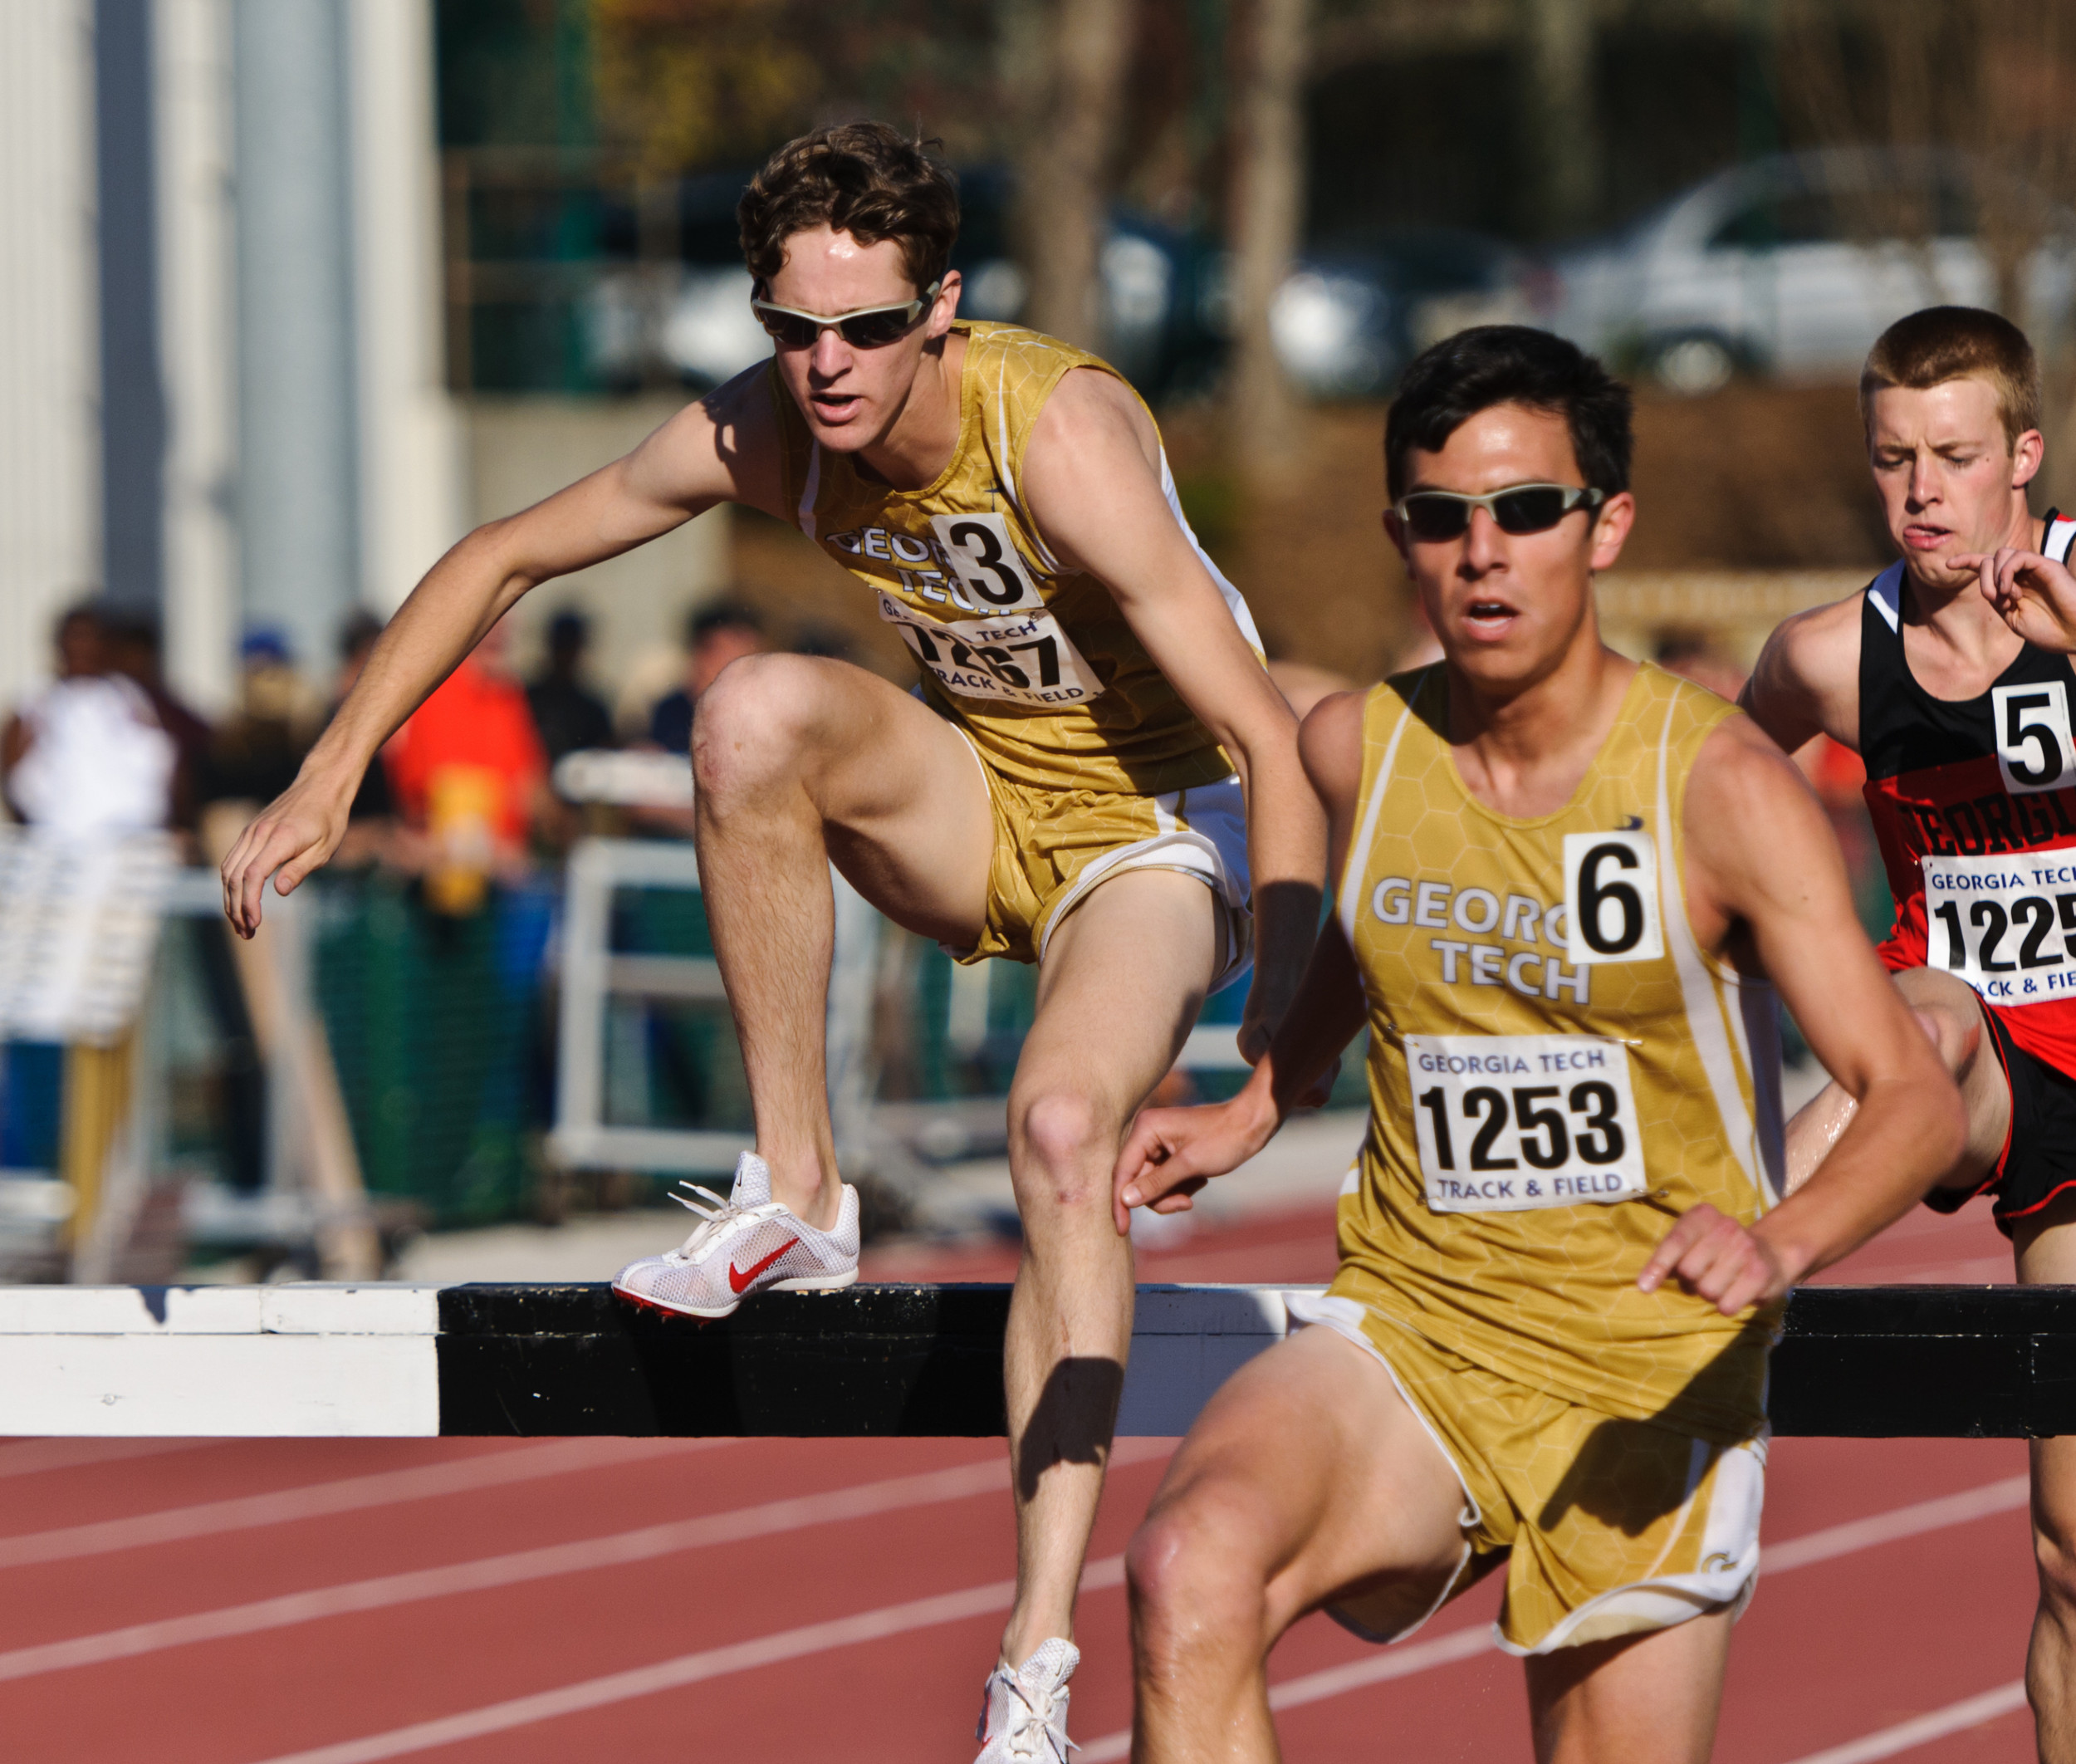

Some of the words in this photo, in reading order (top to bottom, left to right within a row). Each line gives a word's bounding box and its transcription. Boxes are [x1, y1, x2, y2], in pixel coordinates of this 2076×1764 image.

[887, 566, 1011, 615] TEC
[949, 522, 1023, 605] 3
[890, 621, 1060, 688] 1267
[976, 620, 1037, 642] TECH
[930, 667, 996, 690] RACK
[1022, 688, 1084, 703] FIELD
[2006, 693, 2063, 786] 5
[1578, 842, 1644, 955] 6
[1932, 873, 2025, 890] GEORGIA
[1372, 876, 1569, 950] GEORG
[1431, 938, 1590, 1005] TECH
[1975, 982, 2013, 997] ACK
[2023, 978, 2038, 993] &
[2047, 971, 2076, 990] FIE
[1418, 1053, 1531, 1075] GEORGIA
[1539, 1049, 1606, 1073] TECH
[1419, 1080, 1625, 1172] 1253
[1437, 1178, 1515, 1199] TRACK
[1525, 1179, 1542, 1197] &
[1554, 1174, 1623, 1196] FIELD
